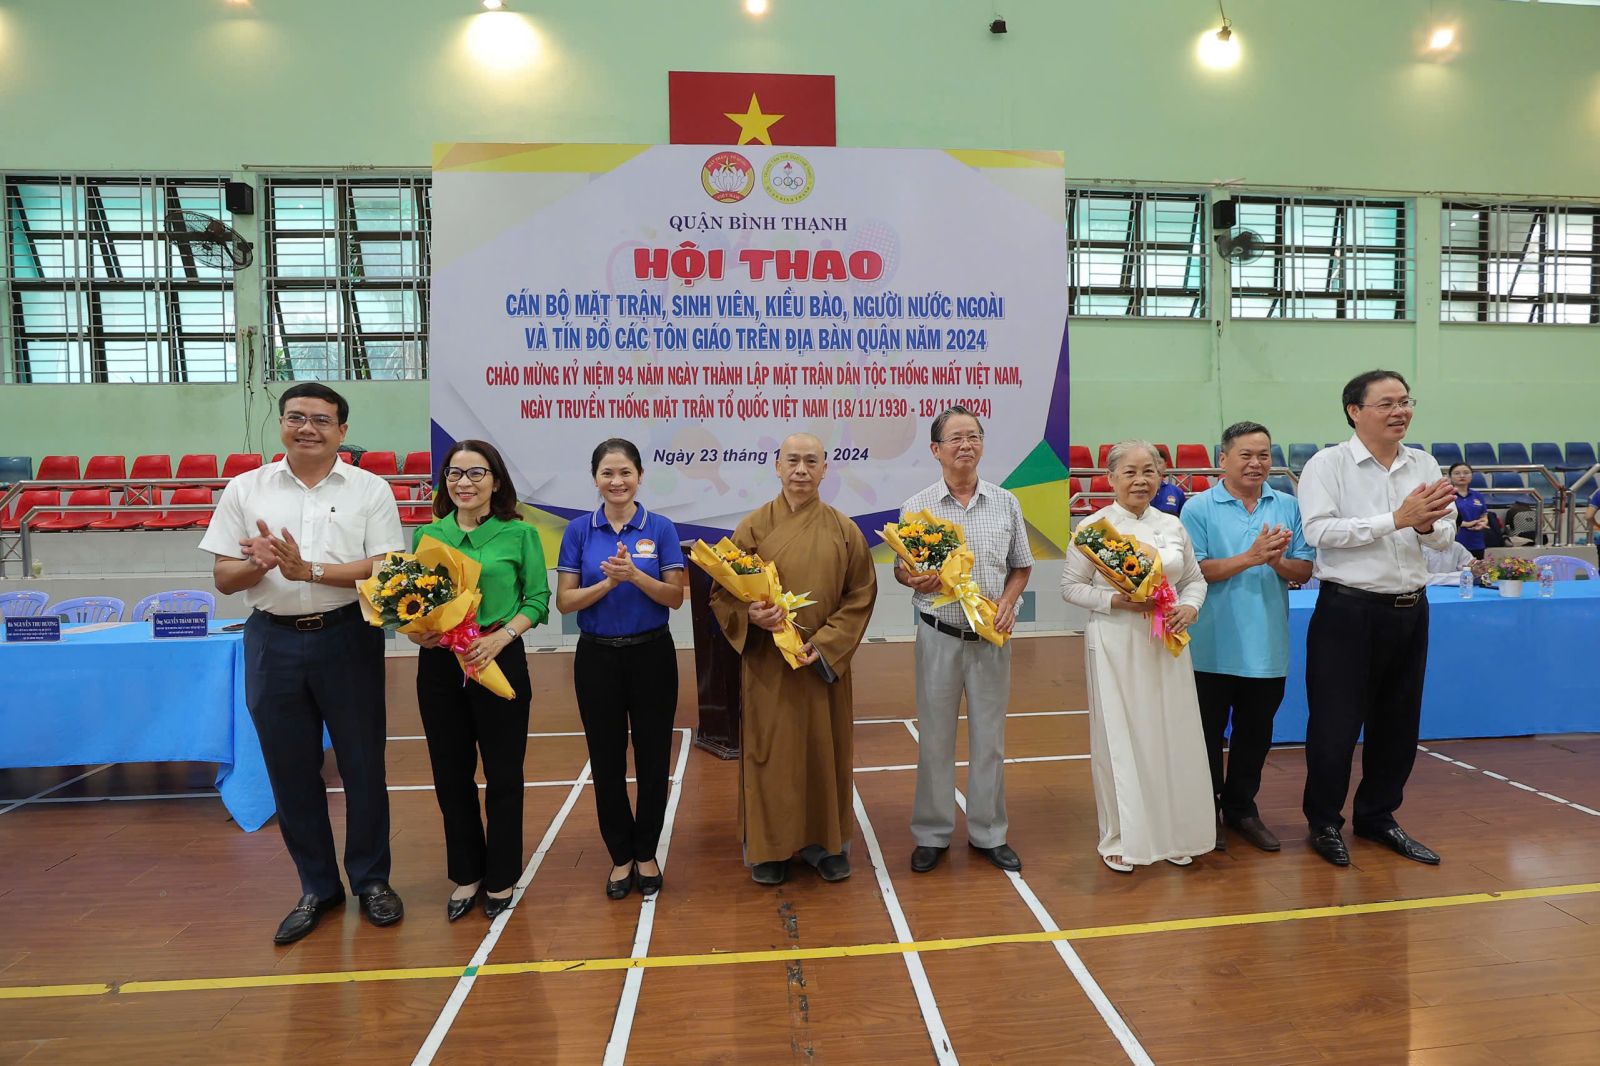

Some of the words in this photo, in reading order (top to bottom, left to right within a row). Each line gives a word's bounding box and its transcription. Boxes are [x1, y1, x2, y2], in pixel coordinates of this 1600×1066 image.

[669, 212, 723, 233] QUẬN
[729, 212, 776, 230] BÌNH
[782, 217, 847, 234] THẠNH
[633, 240, 725, 288] HỘI
[738, 249, 884, 282] THAO
[506, 288, 540, 316] CÁN
[546, 288, 570, 321] BỘ
[575, 290, 611, 321] MẶT
[616, 288, 667, 321] TRẬN,
[672, 294, 711, 317] SINH
[717, 289, 761, 320] VIÊN,
[765, 287, 805, 317] KIỀU
[810, 290, 848, 322] BÀO,
[853, 290, 902, 318] NGƯỜI
[908, 290, 952, 319] NƯỚC
[957, 291, 1004, 319] NGOÀI
[525, 322, 547, 349] VÀ
[553, 322, 581, 349] TÍN
[586, 318, 610, 349] ĐỒ
[615, 322, 649, 349] CÁC
[654, 323, 687, 349] TÔN
[692, 322, 731, 349] GIÁO
[736, 323, 780, 350] TRÊN
[785, 328, 813, 356] ĐỊA
[819, 324, 851, 350] BÀN
[857, 323, 901, 355] QUẬN
[906, 325, 941, 350] NĂM
[946, 329, 986, 350] 2024
[486, 361, 520, 385] CHÀO
[523, 361, 559, 385] MỪNG
[563, 358, 578, 385] KỶ
[583, 361, 614, 389] NIỆM
[618, 366, 633, 385] 94
[637, 362, 664, 385] NĂM
[667, 361, 699, 385] NGÀY
[703, 361, 743, 385] THÀNH
[747, 361, 770, 389] LẬP
[773, 362, 798, 389] MẶT
[801, 361, 833, 389] TRẬN
[837, 362, 860, 385] DÂN
[864, 362, 887, 389] TỘC
[890, 359, 928, 385] THỐNG
[932, 360, 962, 385] NHẤT
[965, 362, 990, 389] VIỆT
[994, 366, 1023, 389] NAM,
[521, 395, 552, 419] NGÀY
[557, 391, 605, 419] TRUYỀN
[608, 392, 650, 419] THỐNG
[653, 396, 679, 422] MẶT
[682, 395, 714, 422] TRẬN
[718, 389, 734, 419] TỔ
[737, 392, 769, 421] QUỐC
[772, 395, 798, 422] VIỆT
[802, 399, 829, 418] NAM
[832, 398, 907, 420] (18/11/1930
[653, 448, 694, 465] Ngày
[700, 449, 718, 462] 23
[723, 448, 767, 465] tháng
[833, 448, 869, 461] 2024
